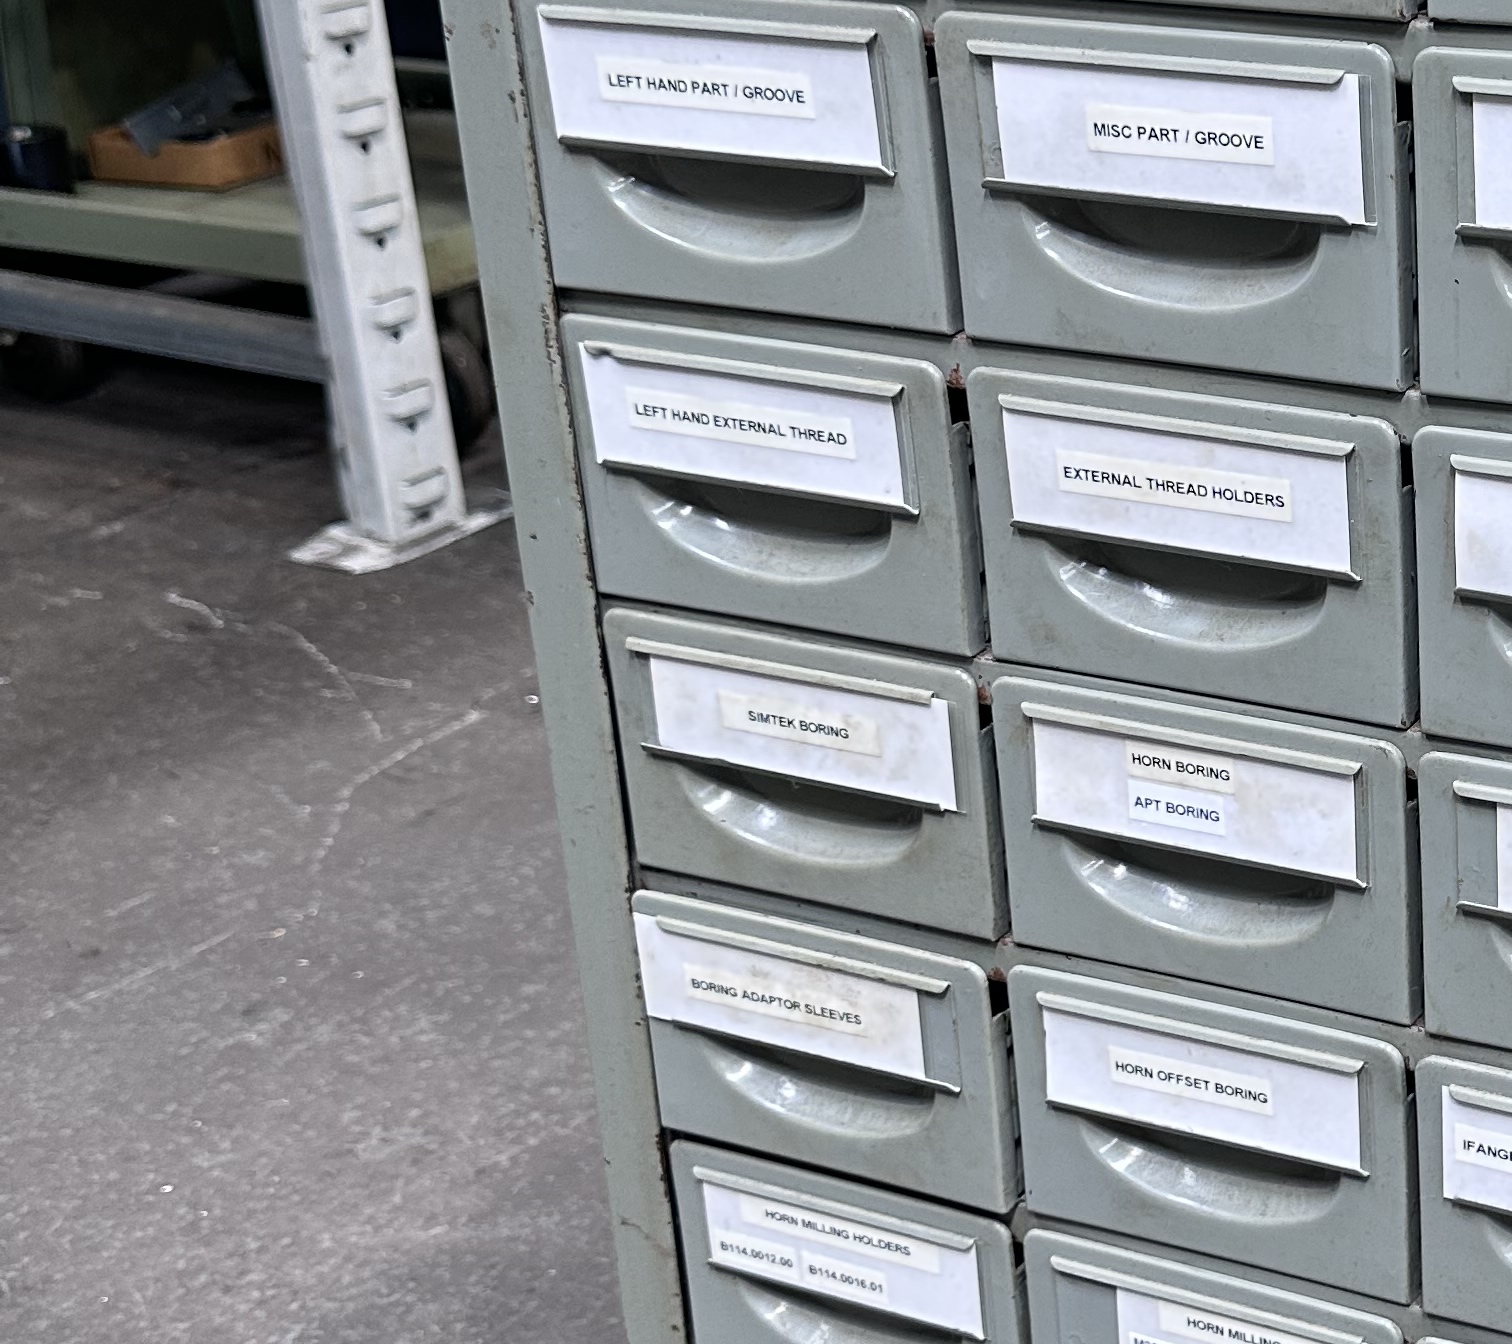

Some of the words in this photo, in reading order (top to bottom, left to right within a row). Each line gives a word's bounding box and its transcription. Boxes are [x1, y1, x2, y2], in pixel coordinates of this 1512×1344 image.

[608, 74, 642, 89] LEFT
[646, 77, 688, 93] HAND
[690, 80, 729, 97] PART
[742, 85, 806, 104] GROOVE
[1093, 122, 1132, 139] MISC
[1137, 126, 1180, 143] PART
[1194, 130, 1265, 150] GROOVE
[634, 403, 668, 419] LEFT
[671, 409, 710, 426] HAND
[713, 414, 787, 437] EXTERNAL
[788, 425, 848, 446] THREAD
[1063, 466, 1143, 489] EXTERNAL
[1145, 477, 1208, 498] THREAD
[1212, 486, 1285, 508] HOLDERS
[748, 710, 797, 730] SIMTEK
[799, 719, 850, 740] BORING
[1131, 752, 1172, 771] HORN
[1175, 760, 1230, 782] BORING
[1134, 796, 1162, 811] APT
[1165, 801, 1220, 823] BORING
[690, 978, 739, 998] BORING
[741, 989, 802, 1012] ADAPTOR
[804, 1003, 862, 1026] SLEEVES
[1115, 1060, 1154, 1079] HORN
[1157, 1070, 1211, 1091] OFFSET
[1214, 1082, 1268, 1104] BORING
[765, 1209, 799, 1226] HORN
[801, 1218, 850, 1240] MILLING
[852, 1232, 912, 1257] HOLDERS
[1186, 1317, 1225, 1337] HORN
